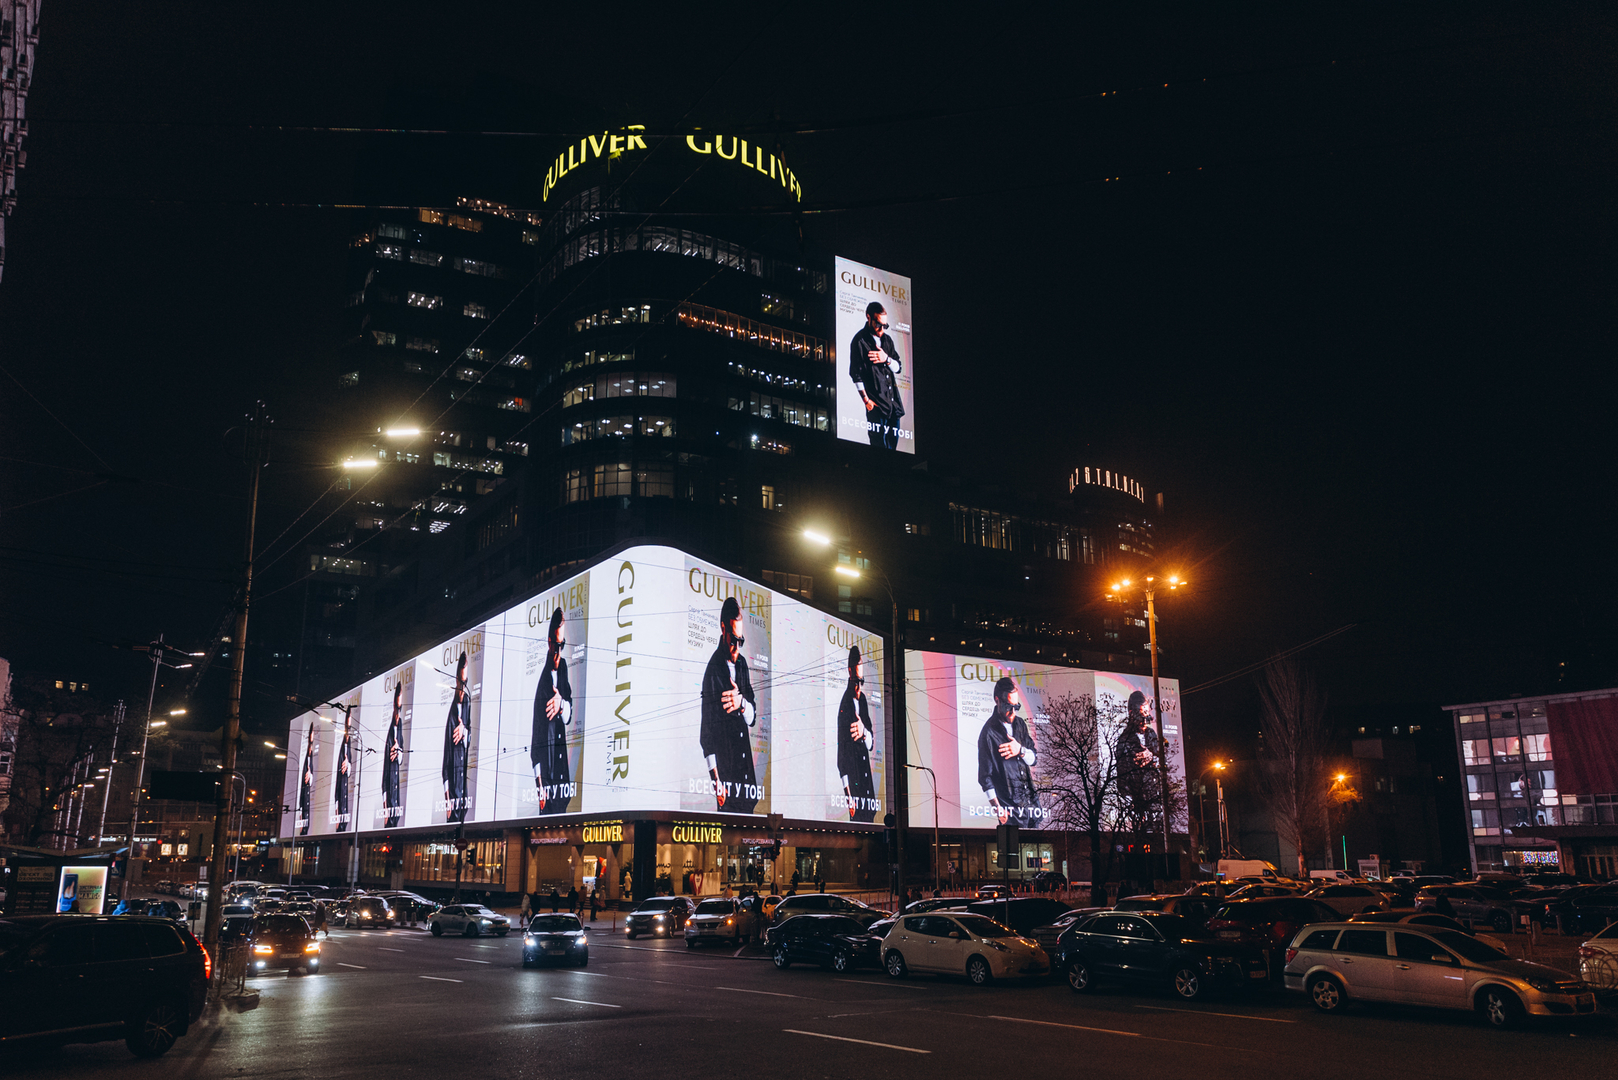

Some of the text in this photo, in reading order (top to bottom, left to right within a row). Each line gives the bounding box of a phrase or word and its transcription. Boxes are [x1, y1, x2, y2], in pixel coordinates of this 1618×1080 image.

[543, 124, 647, 202] GULLIVER
[841, 271, 906, 300] GULLIVER
[842, 416, 913, 440] ВСЕСВІТ У ТОБІ
[689, 567, 765, 618] GULLIVER
[528, 583, 584, 628] GULLIVER
[749, 615, 767, 629] TIMES
[827, 624, 878, 660] GULLIVER
[612, 561, 635, 783] GULLIVER
[961, 663, 1045, 687] GULLIVER
[522, 782, 577, 802] ВСЕСВІТ У ТОБІ
[689, 778, 765, 800] ВСЕСВІТ У ТОБІ
[831, 795, 882, 811] ВСЕСВІТ У ТОБІ
[969, 805, 1051, 818] ВСЕСВІТ У ТОБІ
[583, 825, 623, 843] GULLIVER
[672, 826, 722, 843] GULLIVER
